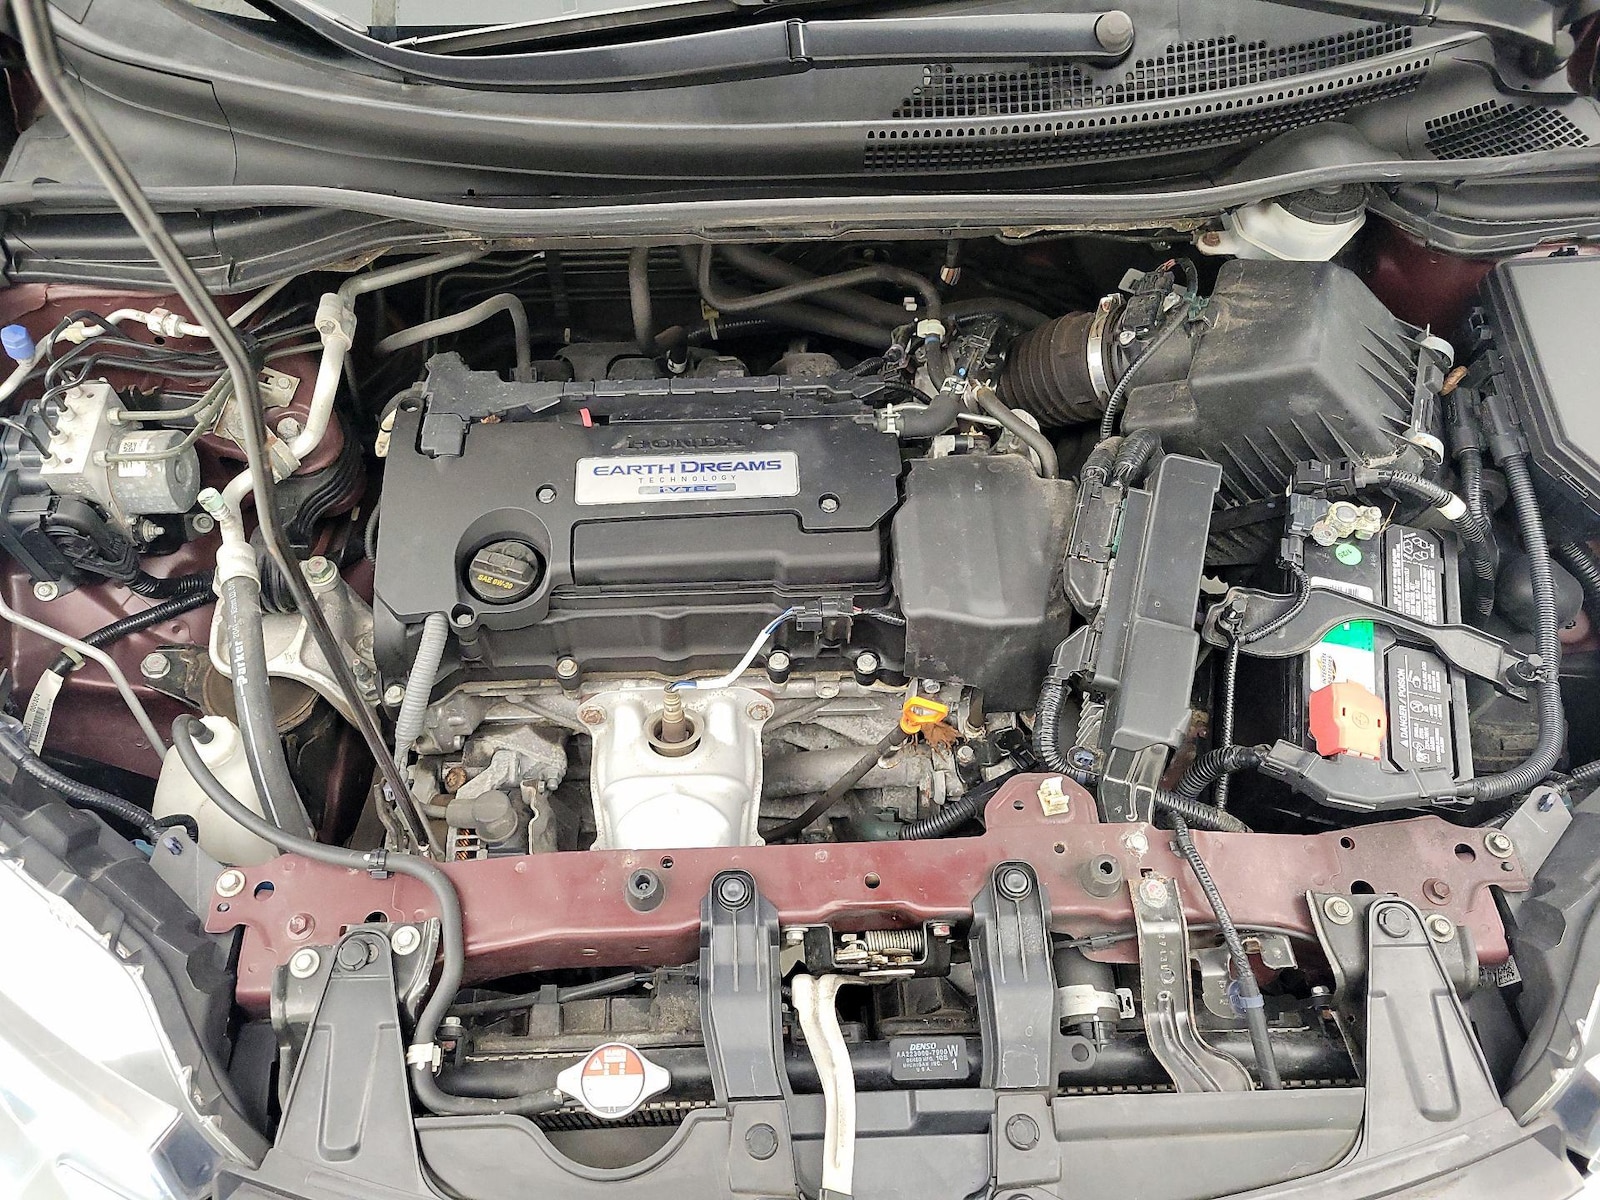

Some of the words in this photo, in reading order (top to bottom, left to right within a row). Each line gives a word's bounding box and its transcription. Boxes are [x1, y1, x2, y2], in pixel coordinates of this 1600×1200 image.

[626, 437, 745, 450] HONDA
[593, 463, 676, 476] EARTH
[680, 460, 782, 473] DREAMS
[638, 474, 737, 484] TECHNOLOGY
[477, 574, 493, 584] SAE
[492, 578, 514, 590] 0W-20
[234, 641, 248, 687] Parker
[1397, 668, 1407, 697] POISON
[1399, 705, 1409, 739] DANGER
[909, 1042, 937, 1051] DENSO
[947, 1044, 959, 1057] W
[951, 1057, 958, 1071] 1
